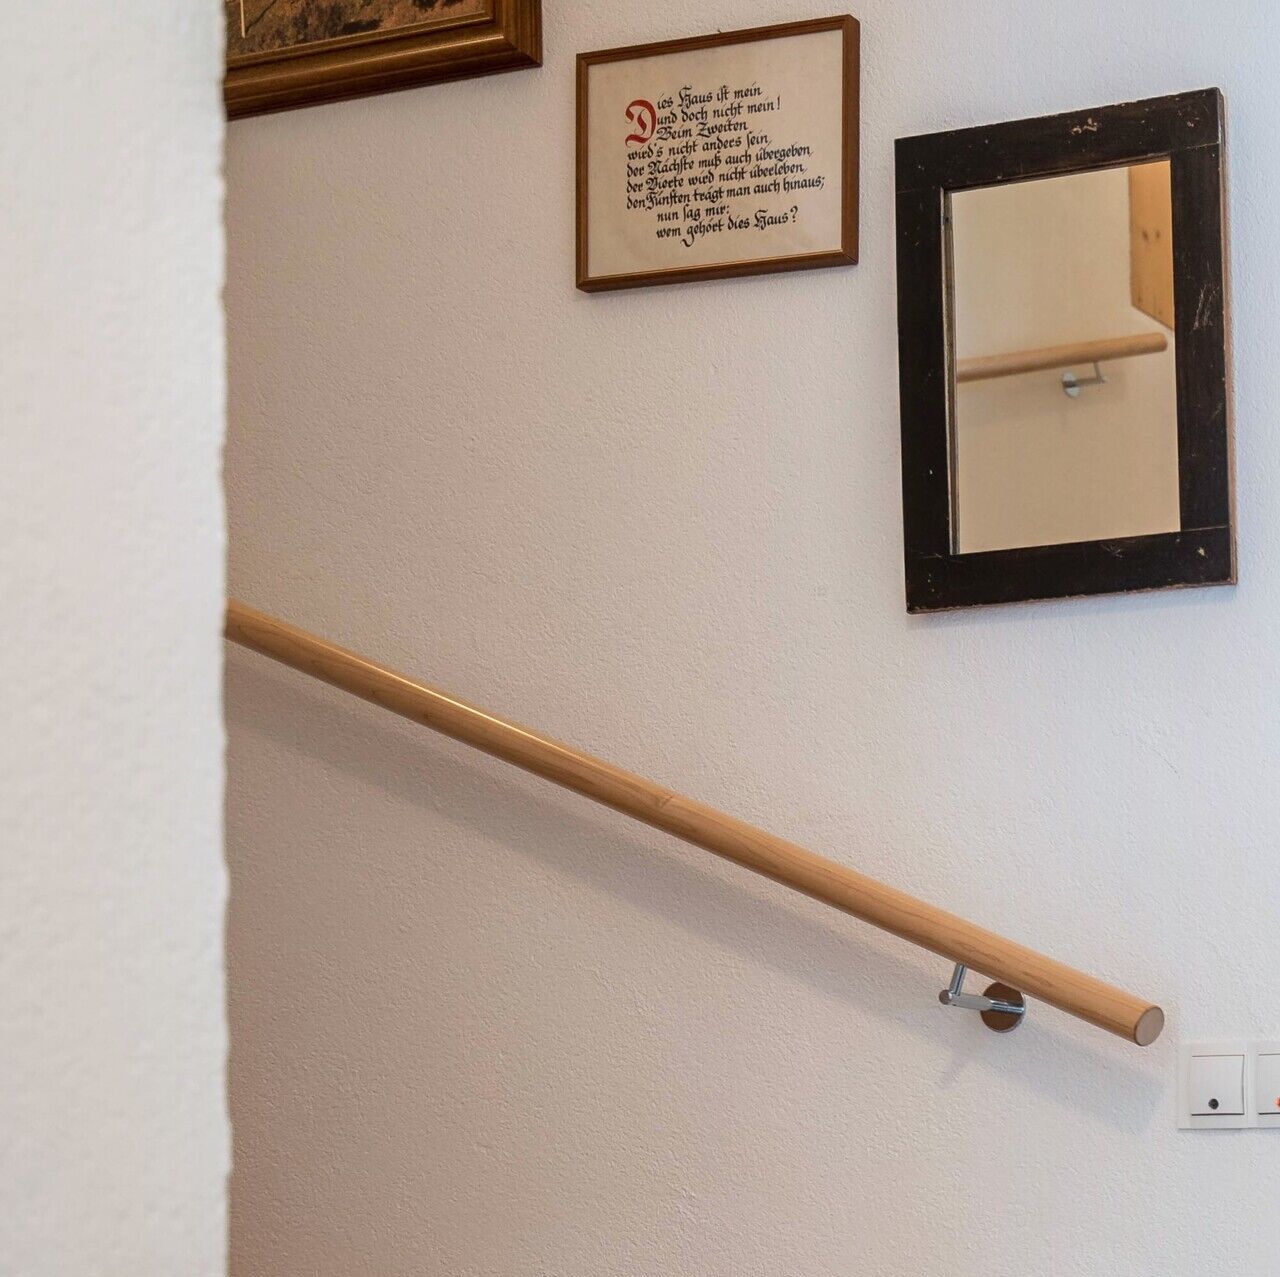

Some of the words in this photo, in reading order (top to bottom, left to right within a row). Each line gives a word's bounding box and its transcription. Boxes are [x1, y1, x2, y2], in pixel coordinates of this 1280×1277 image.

[677, 84, 713, 109] Haus
[733, 81, 762, 99] mein
[657, 108, 678, 125] und
[681, 105, 708, 122] doch
[713, 100, 743, 119] nicht
[656, 124, 692, 141] Beim
[696, 117, 748, 139] Zweiten
[668, 139, 699, 156] nicht
[702, 135, 742, 151] anders
[626, 163, 645, 178] der
[725, 150, 752, 166] auch
[626, 179, 644, 194] der
[645, 175, 684, 191] Vierte
[688, 169, 715, 186] wird
[718, 165, 747, 182] nicht
[626, 194, 646, 210] den
[726, 185, 751, 198] man
[753, 178, 780, 194] auch
[656, 227, 682, 239] wem
[727, 215, 750, 231] dies
[657, 211, 680, 222] nun
